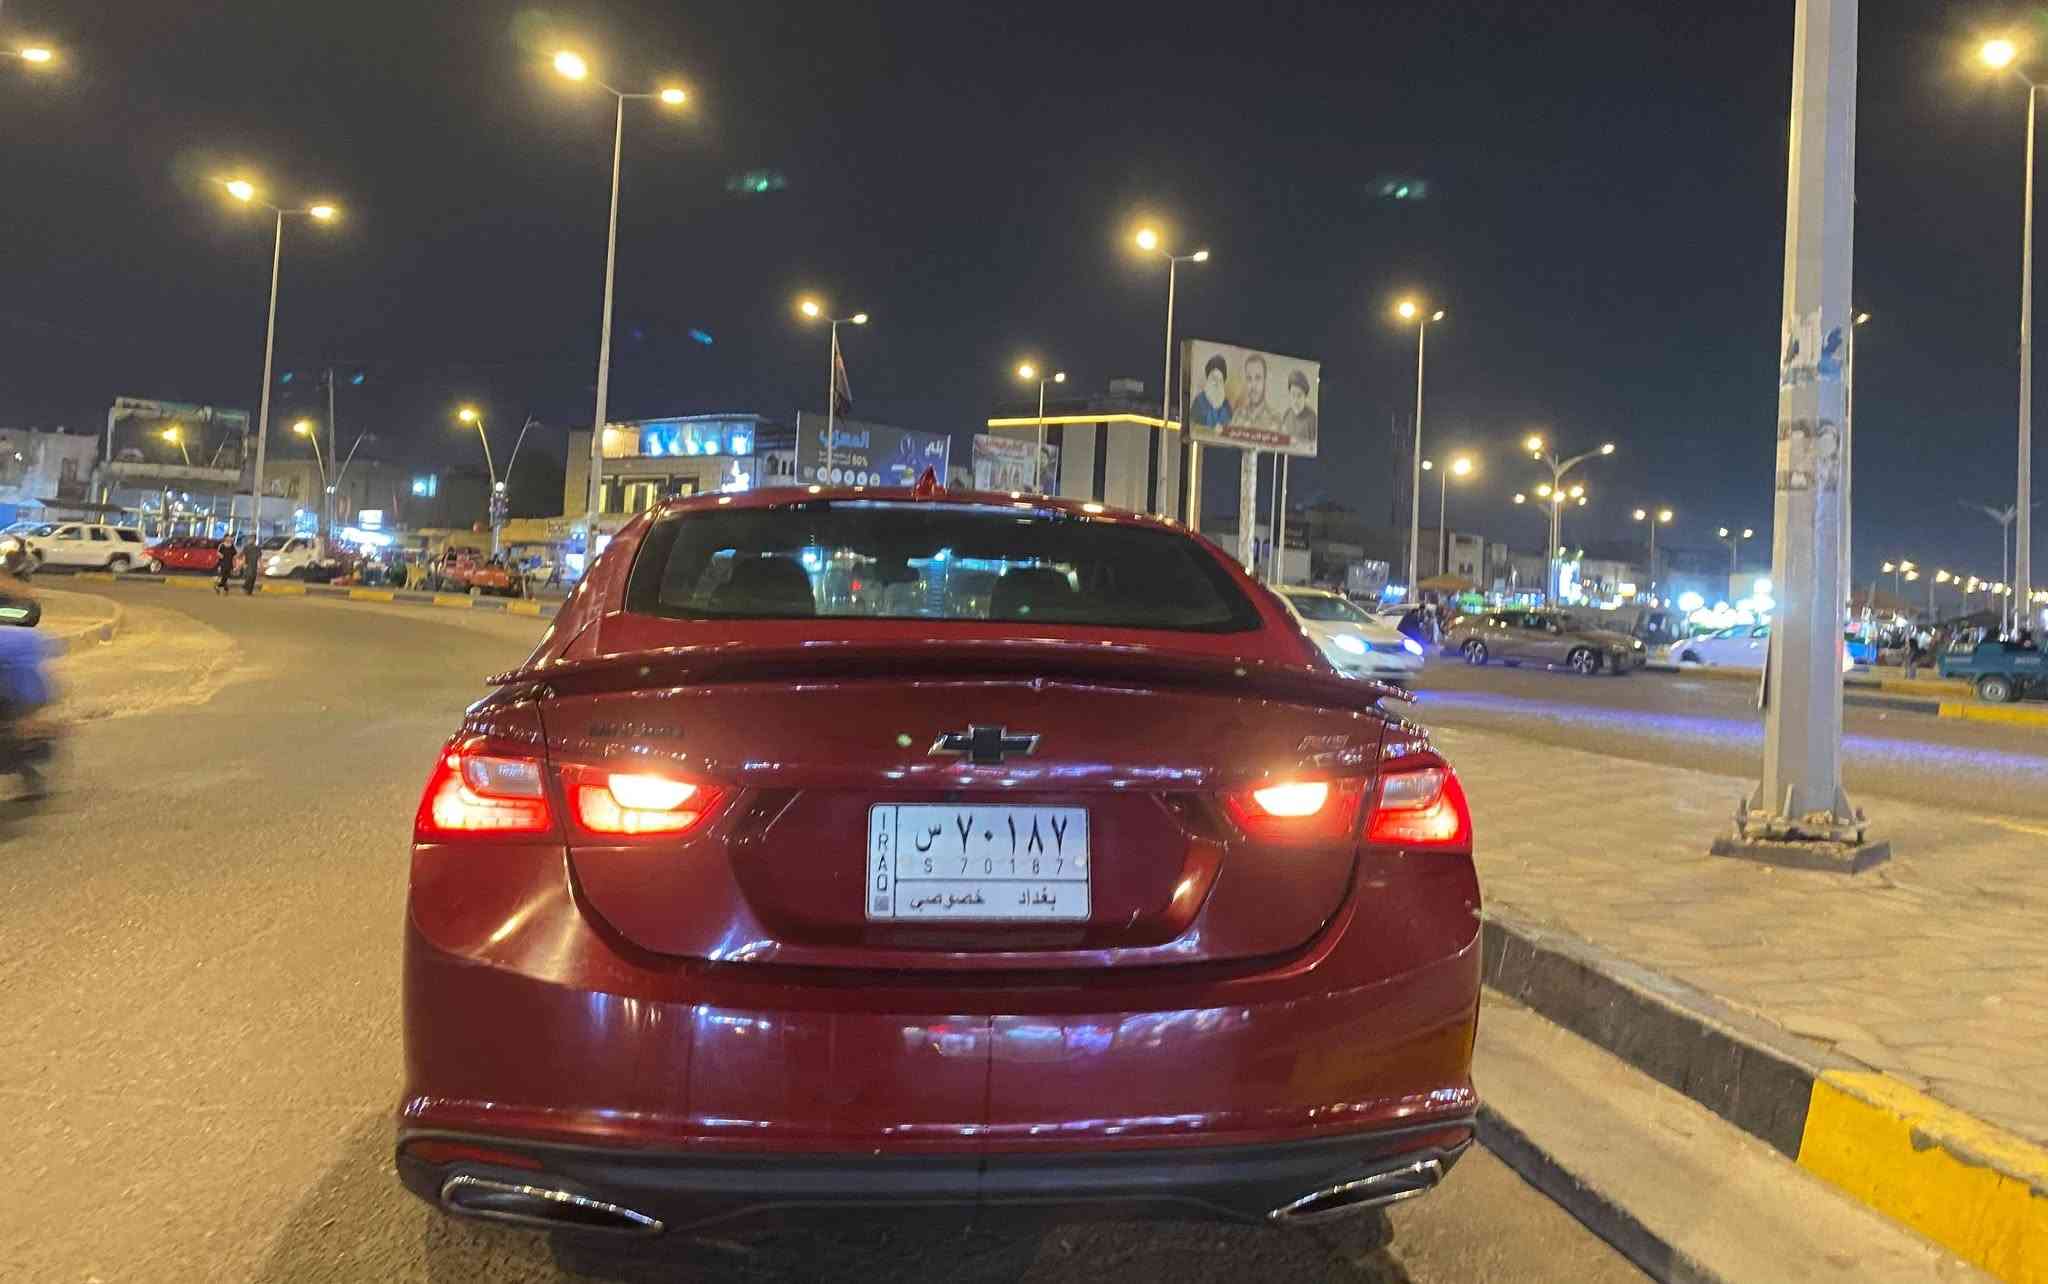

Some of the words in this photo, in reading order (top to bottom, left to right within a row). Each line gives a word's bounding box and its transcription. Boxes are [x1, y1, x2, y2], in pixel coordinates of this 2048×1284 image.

[877, 812, 888, 891] IRAQ
[960, 858, 1064, 874] 70187
[910, 888, 985, 912] خصوصي
[1018, 886, 1057, 911] بغداد
